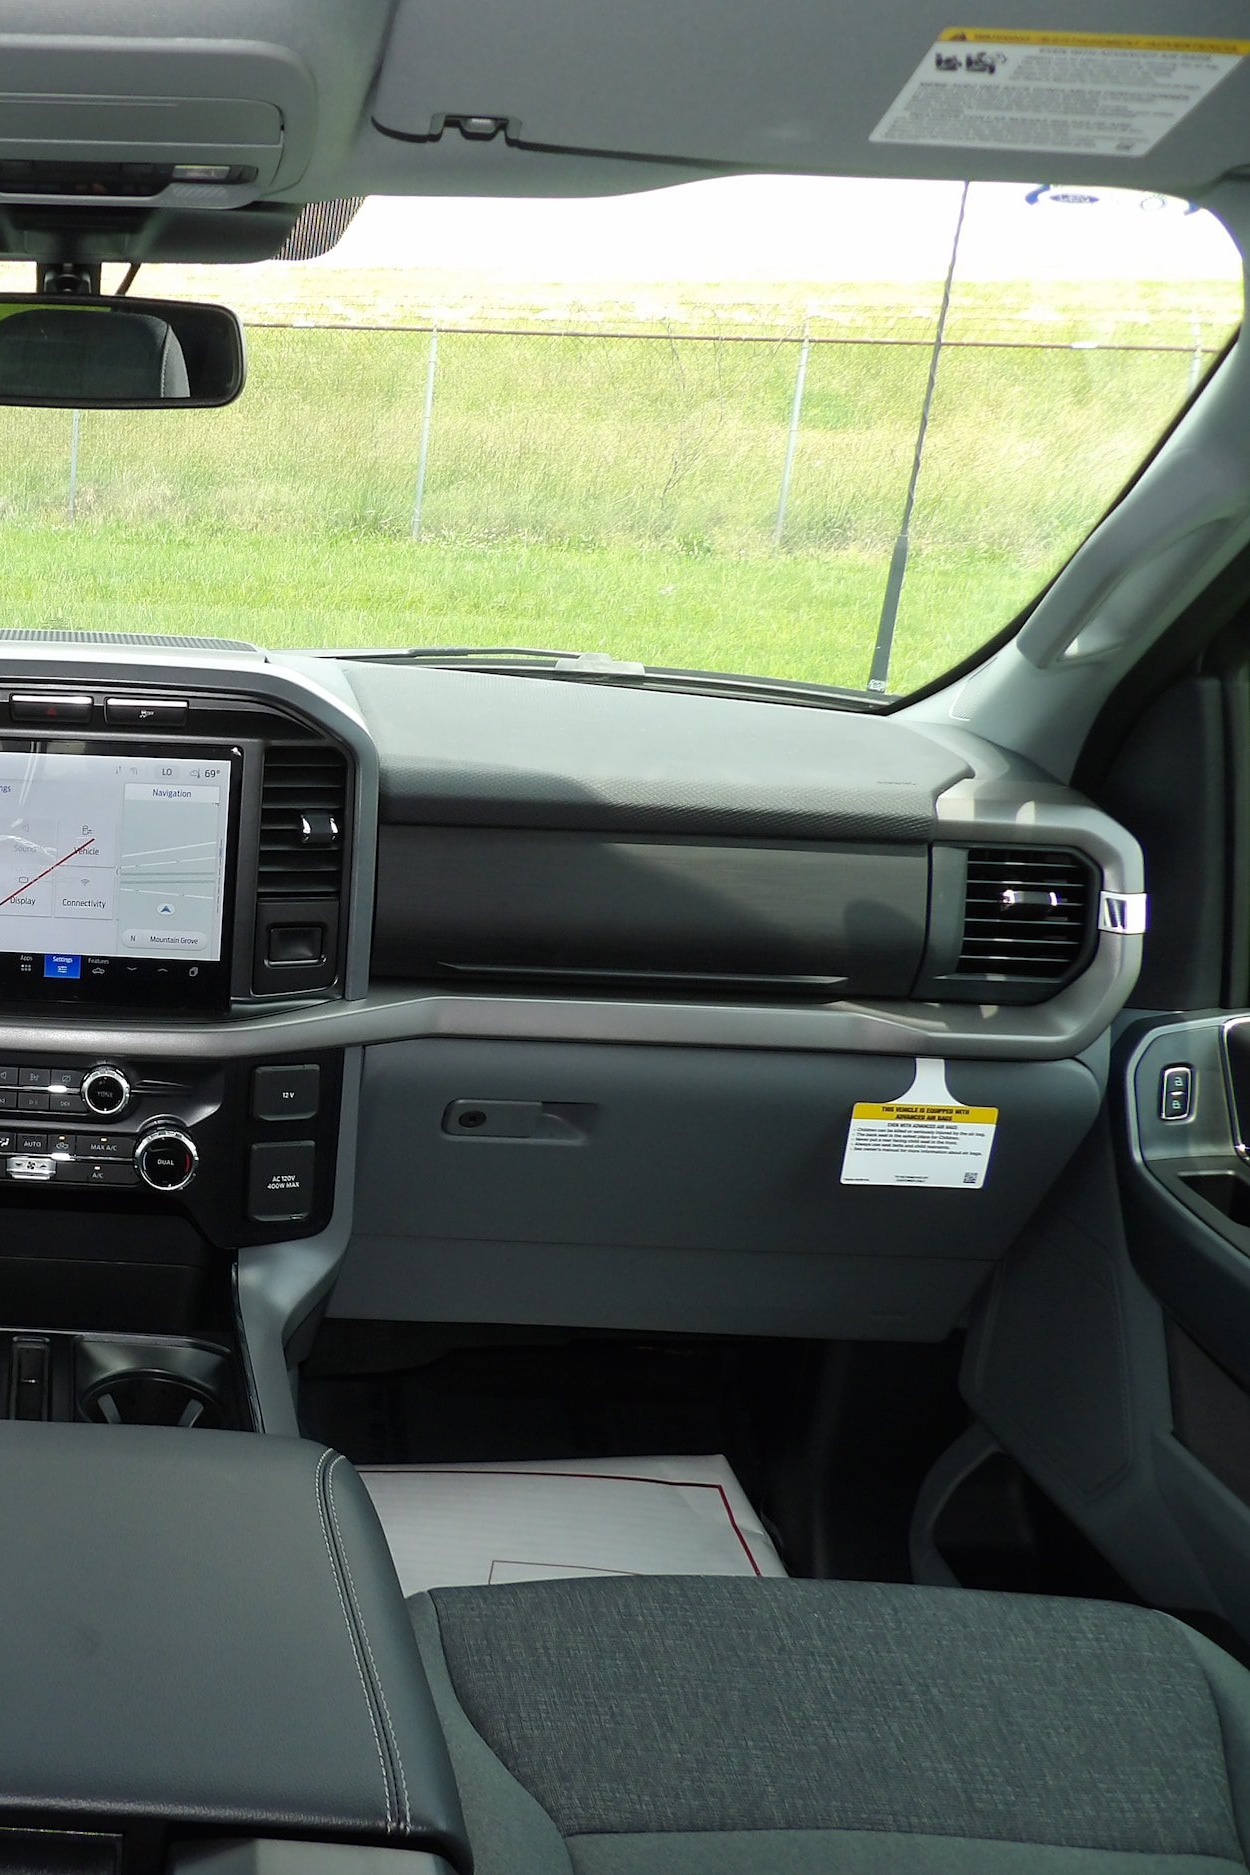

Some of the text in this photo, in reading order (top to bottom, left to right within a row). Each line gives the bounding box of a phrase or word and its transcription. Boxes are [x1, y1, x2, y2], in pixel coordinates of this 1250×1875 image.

[162, 768, 172, 776] LO
[204, 770, 220, 778] 69°
[152, 789, 192, 798] Navigation
[14, 845, 36, 853] Sound
[74, 847, 99, 855] Vehicle
[10, 897, 36, 906] Display
[62, 899, 106, 909] Connectivity
[150, 936, 179, 944] Mountain
[157, 1158, 174, 1166] DUAL
